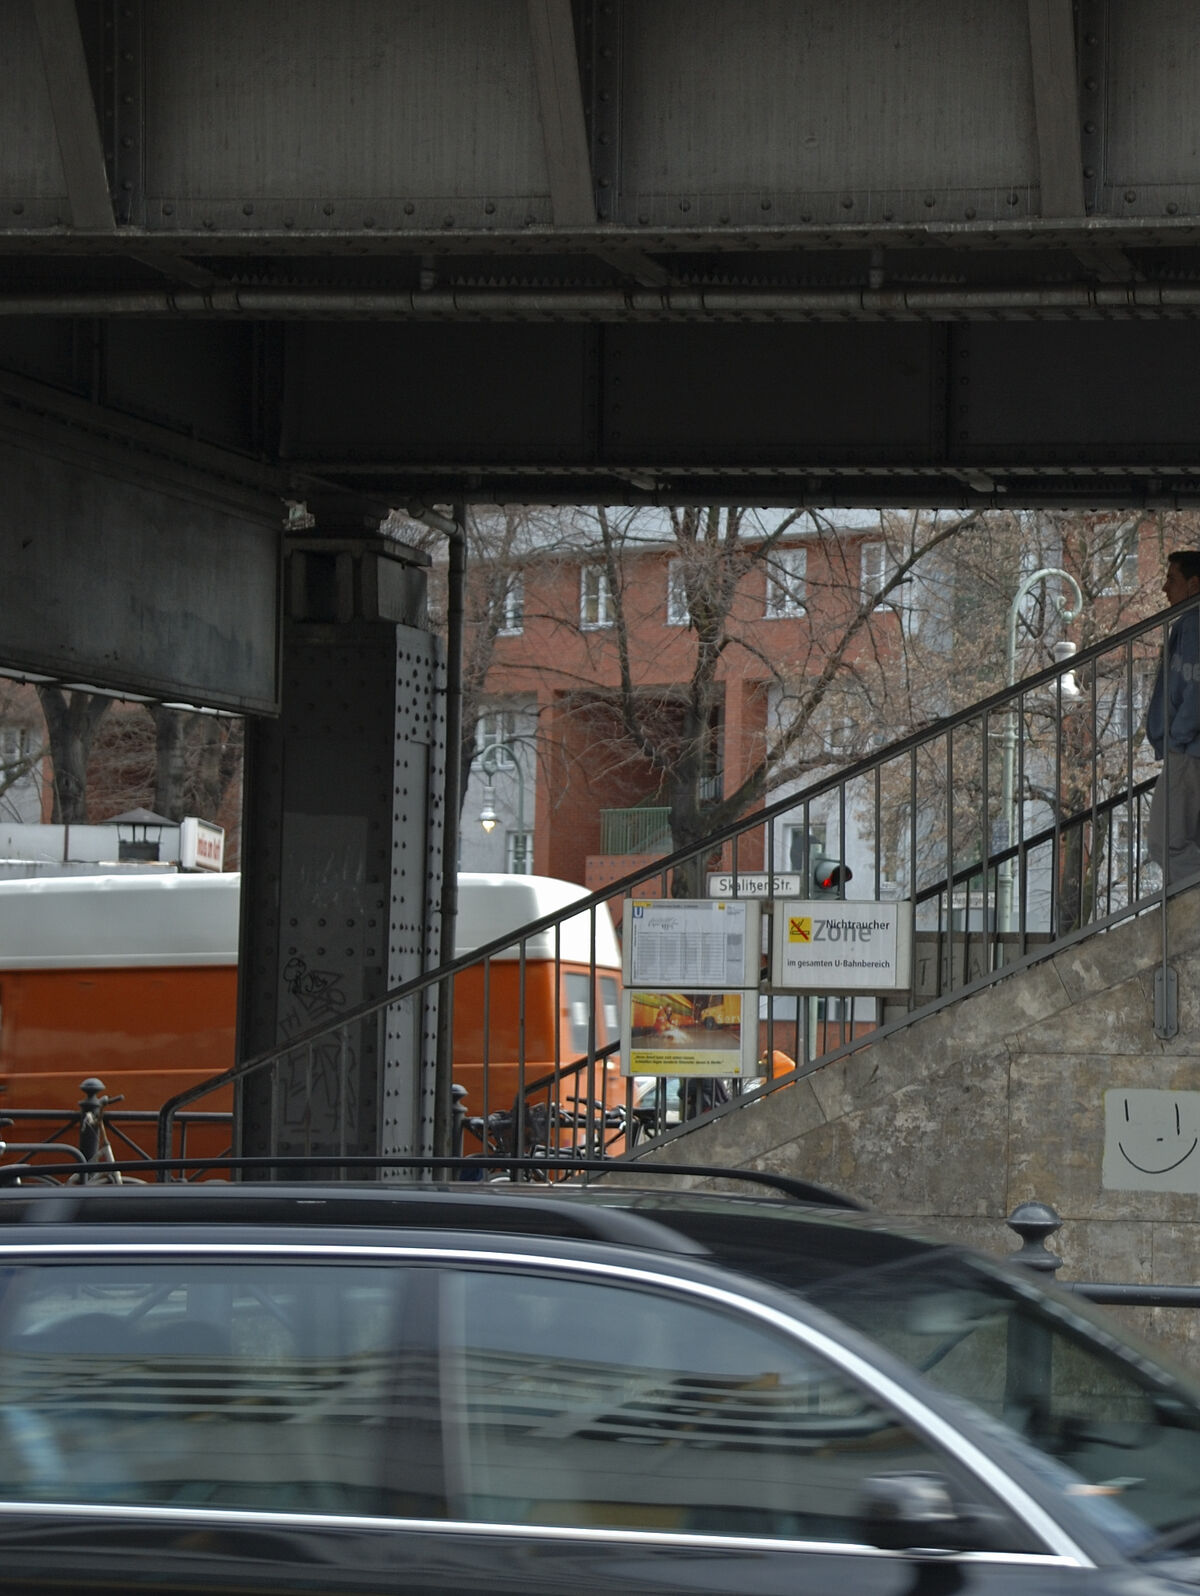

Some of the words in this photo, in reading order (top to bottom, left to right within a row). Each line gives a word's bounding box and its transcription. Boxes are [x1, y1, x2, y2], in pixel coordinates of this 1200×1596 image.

[773, 878, 792, 891] Str.
[633, 906, 643, 917] U
[826, 919, 890, 930] Nichtraucher
[813, 920, 873, 942] Zone
[787, 959, 796, 967] im
[797, 960, 833, 968] gesamten
[834, 959, 890, 968] U-Bahnbereich
